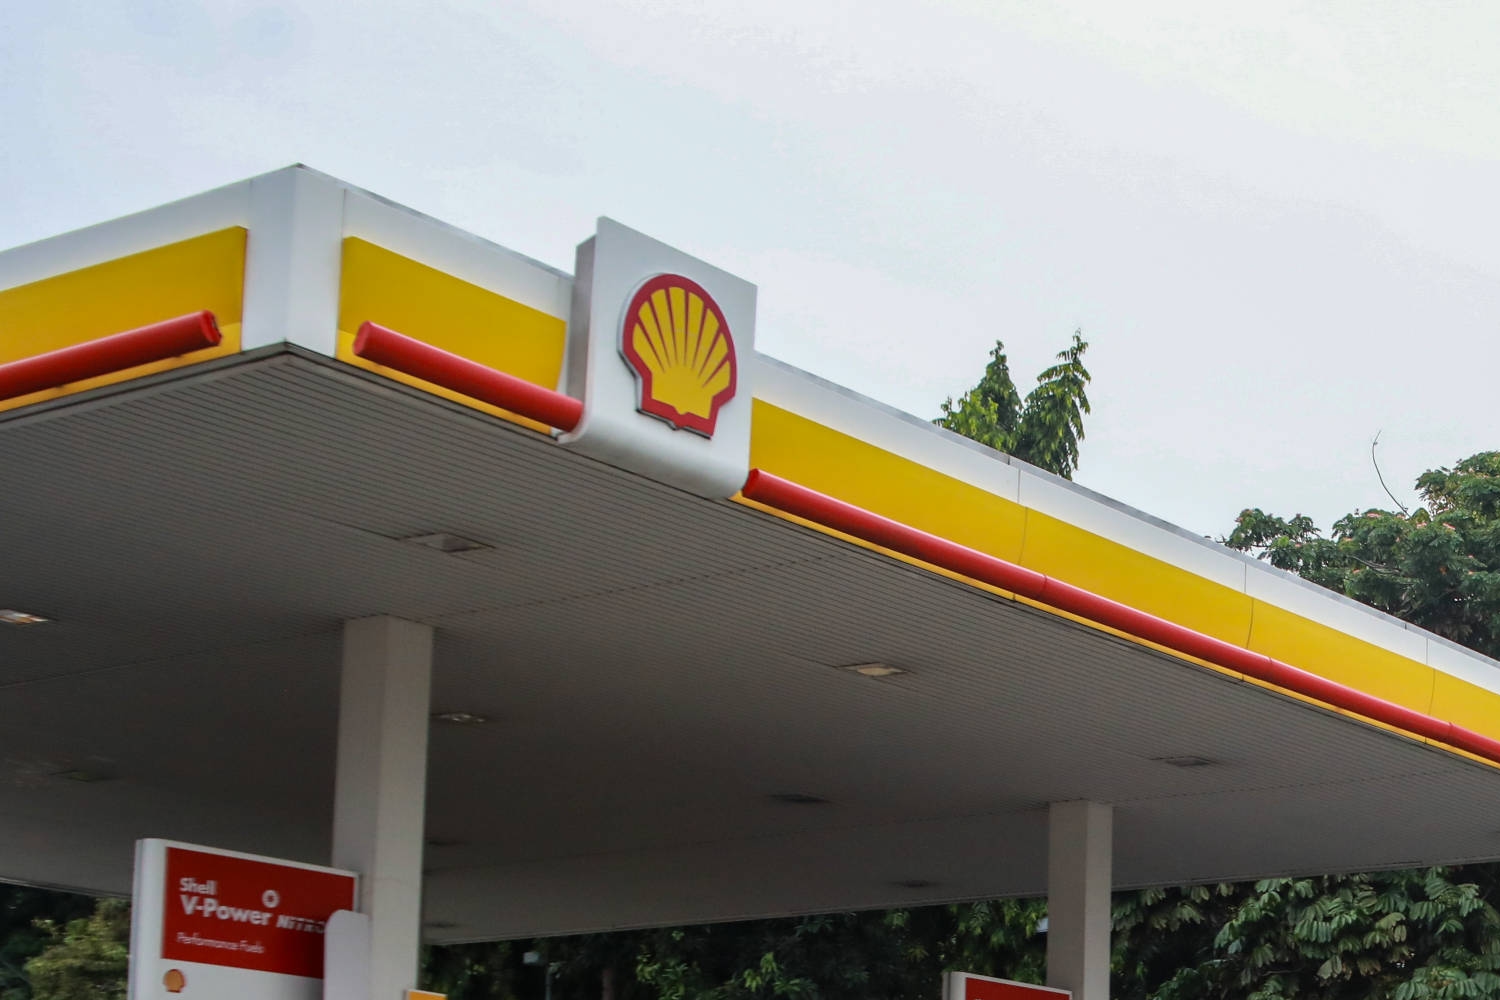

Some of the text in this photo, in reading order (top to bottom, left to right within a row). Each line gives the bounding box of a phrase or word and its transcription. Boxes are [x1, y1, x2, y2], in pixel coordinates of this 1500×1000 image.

[180, 877, 216, 896] Shell
[180, 894, 272, 927] V-Power
[176, 931, 265, 954] Performance Fuels
